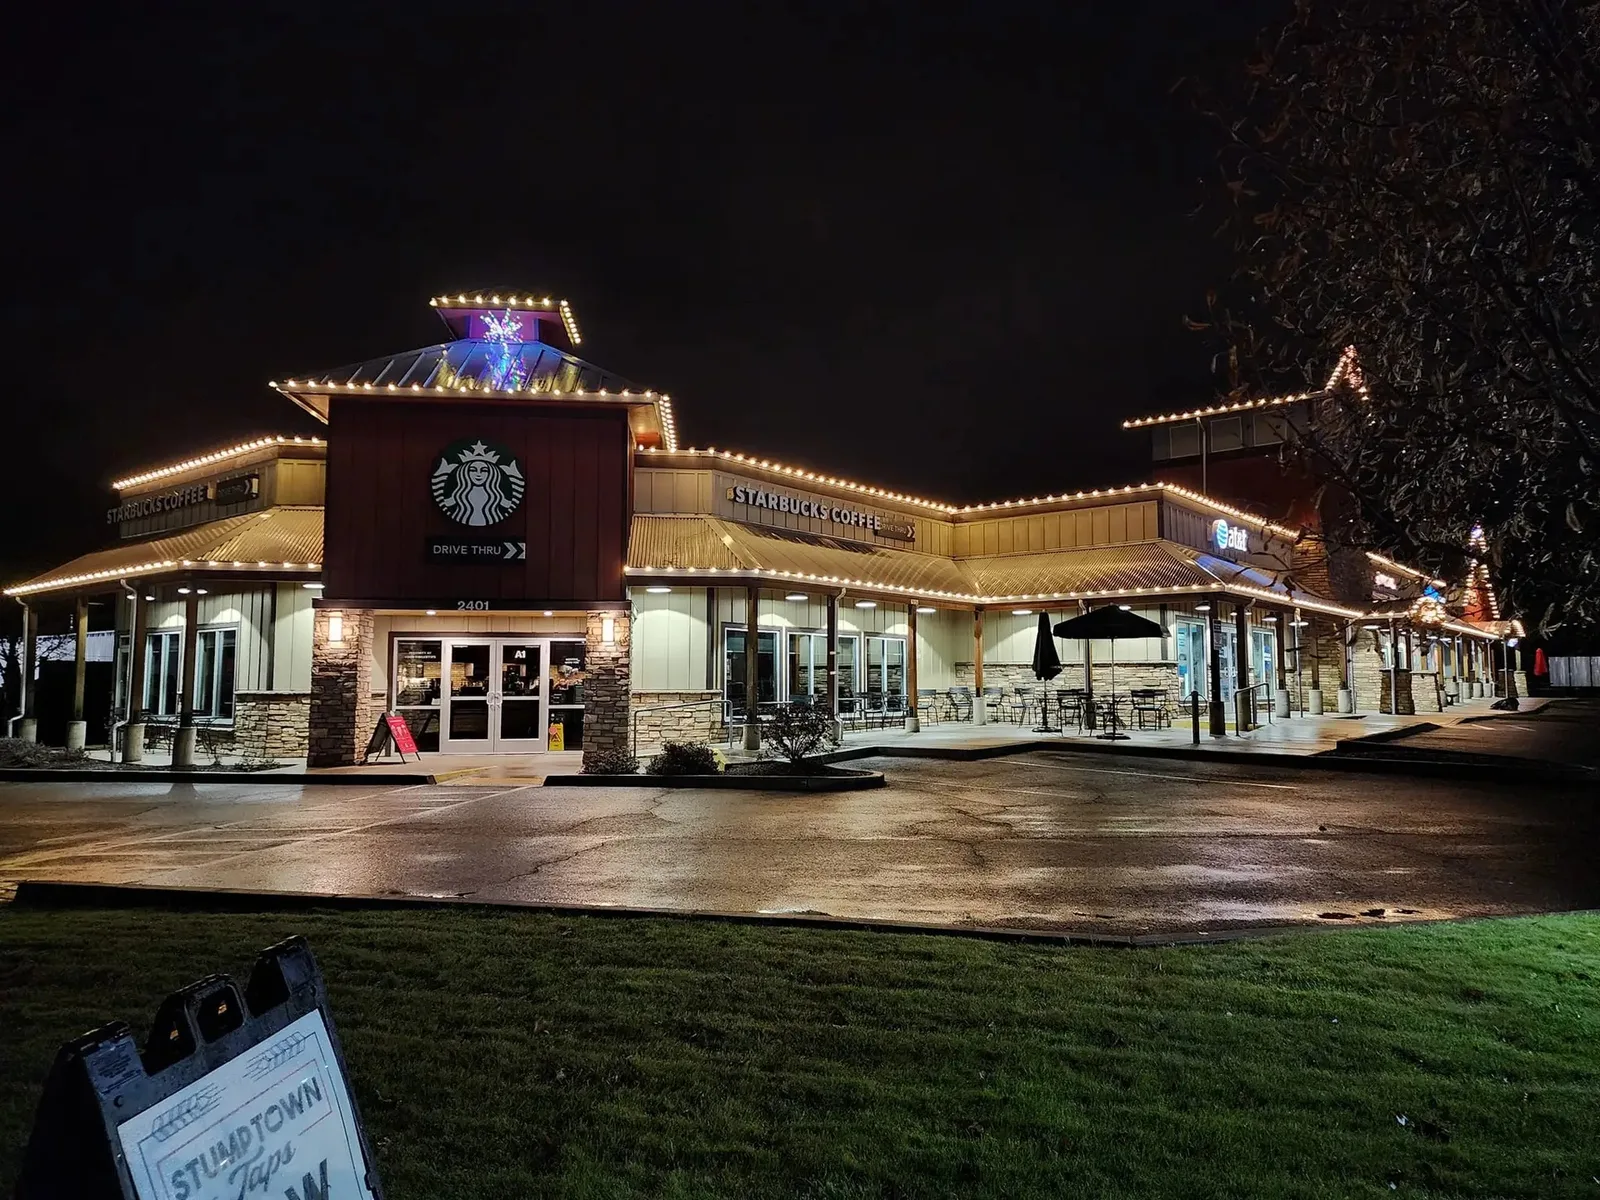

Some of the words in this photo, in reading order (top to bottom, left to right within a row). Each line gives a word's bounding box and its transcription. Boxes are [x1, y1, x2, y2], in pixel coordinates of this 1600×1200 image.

[106, 498, 162, 525] STARBUCKS
[163, 486, 204, 511] COFFEE
[735, 485, 828, 520] STARBUCKS
[831, 507, 881, 530] COFFEE
[433, 545, 468, 555] DRIVE
[471, 545, 501, 555] THRU
[457, 600, 490, 611] 2401
[514, 649, 526, 659] A1
[171, 1076, 323, 1200] STUMPTOWN
